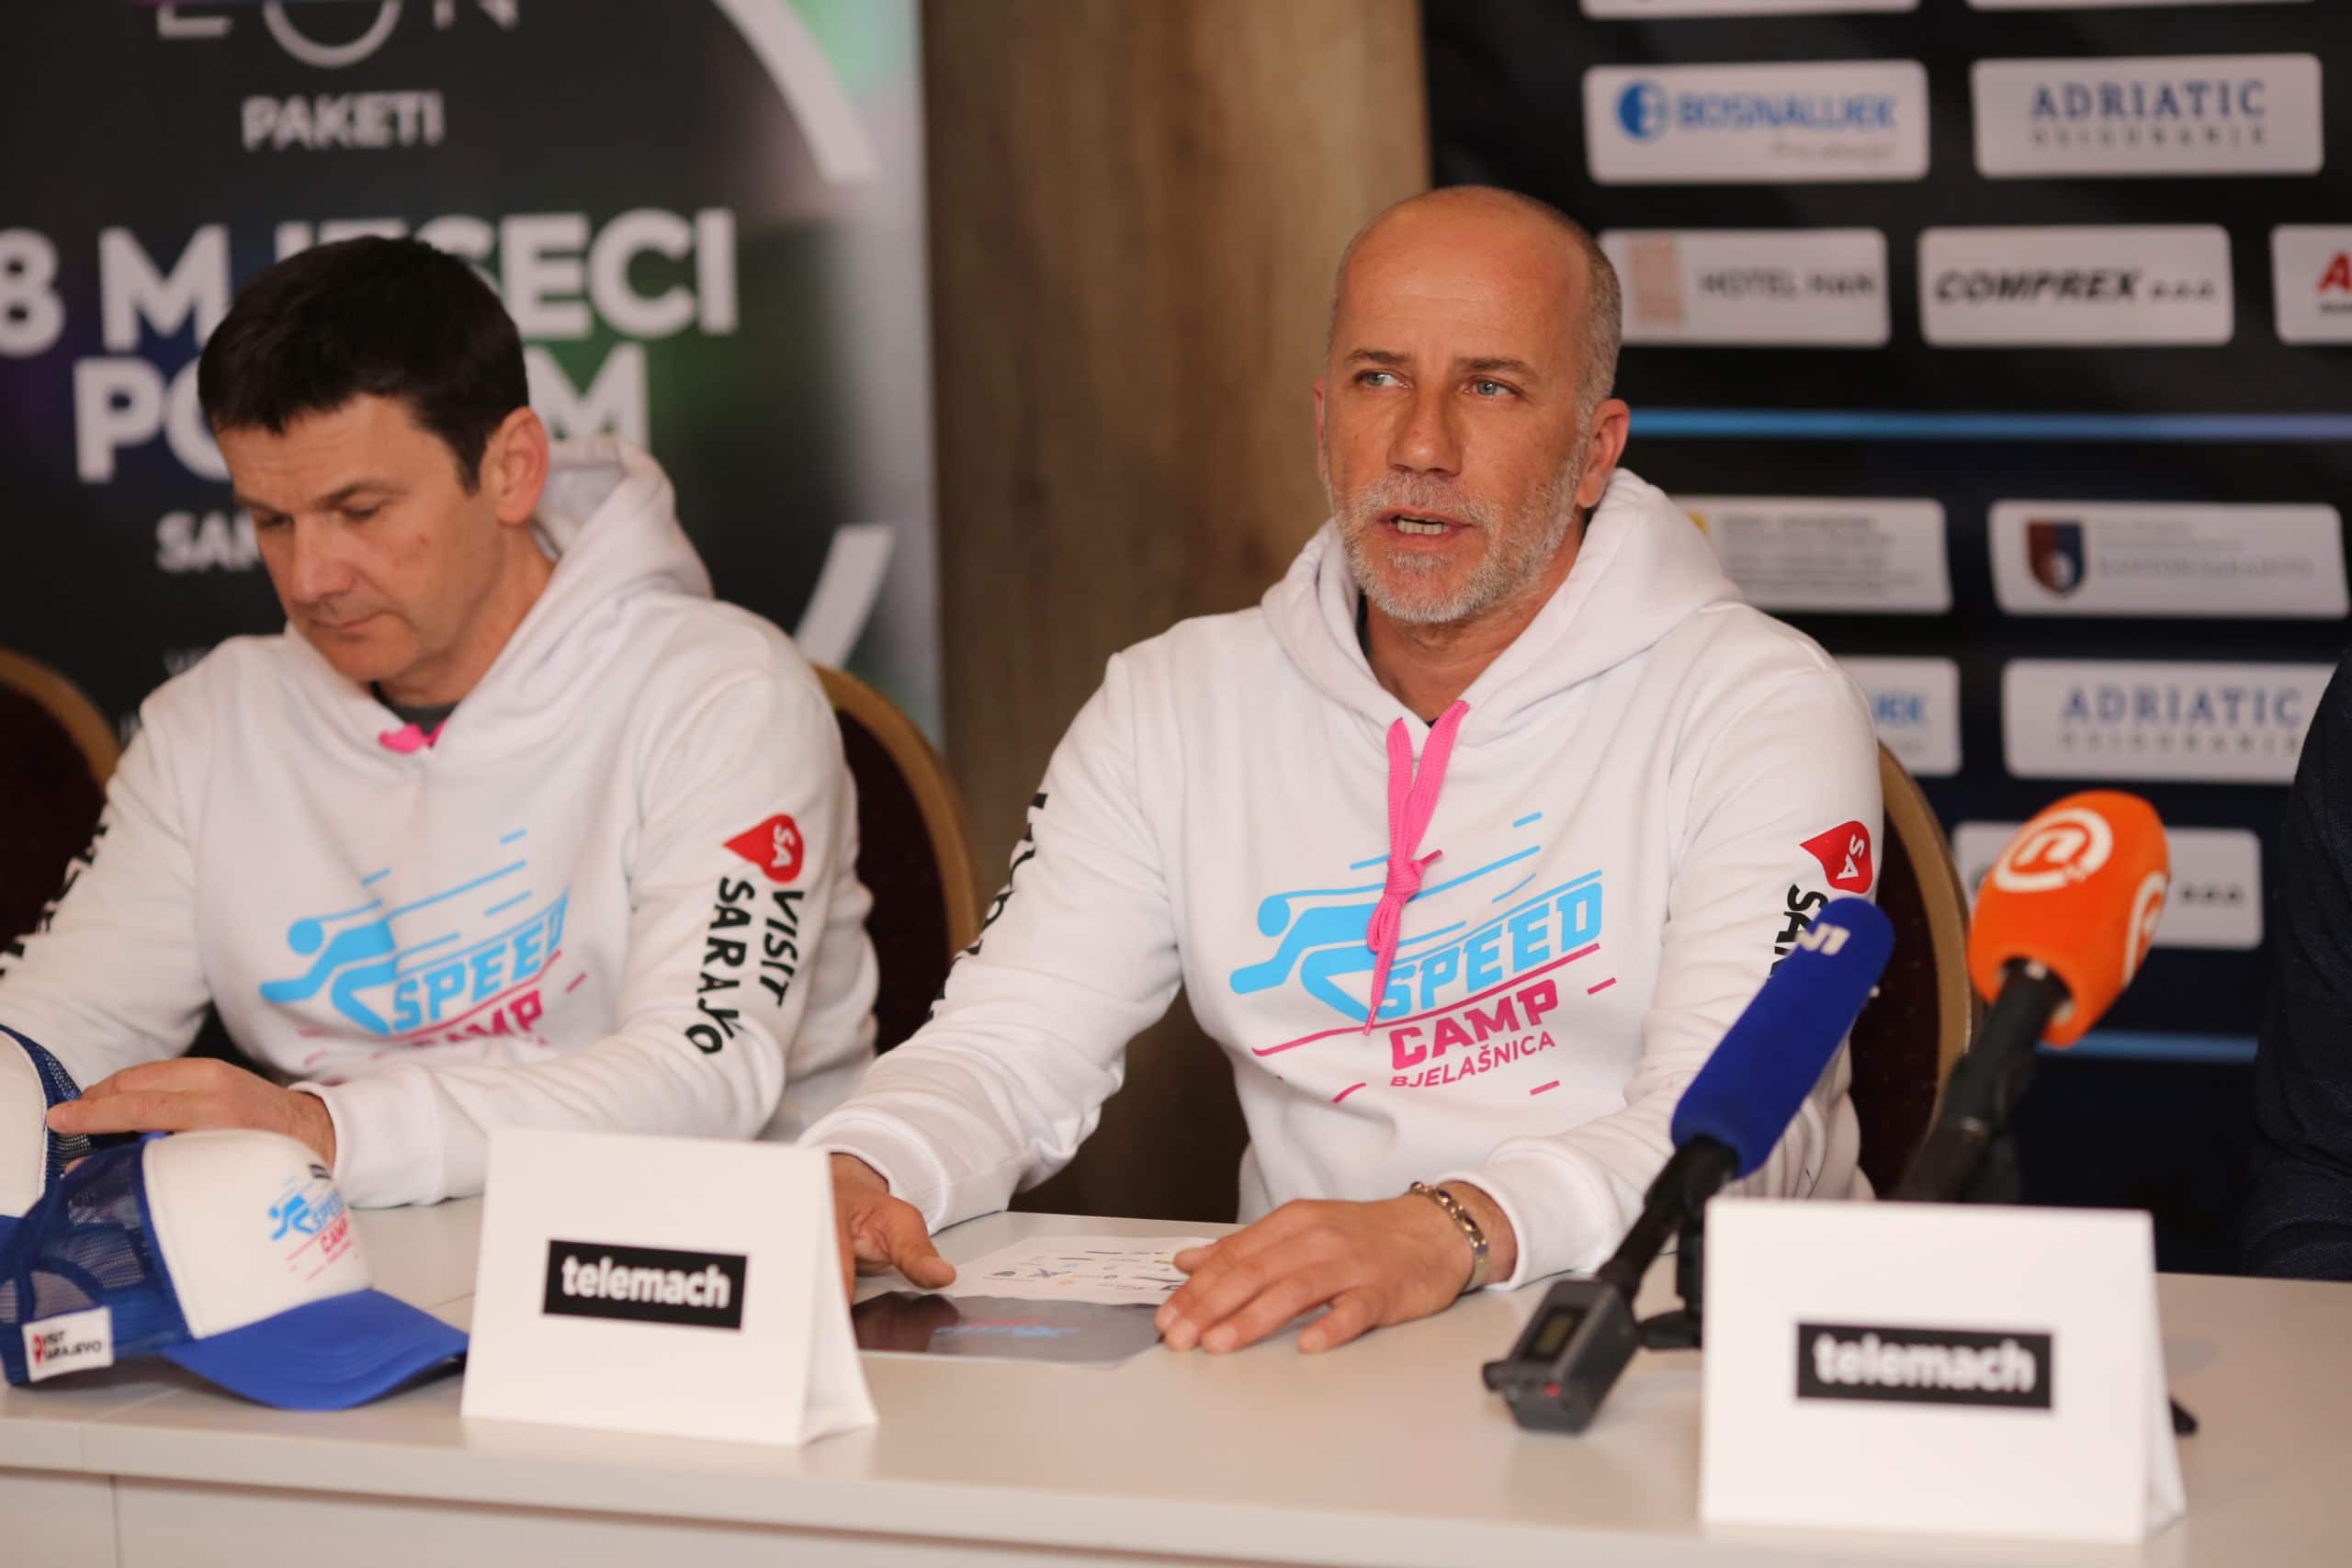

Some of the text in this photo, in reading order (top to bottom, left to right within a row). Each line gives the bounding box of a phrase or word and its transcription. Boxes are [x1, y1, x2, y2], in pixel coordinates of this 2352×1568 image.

[241, 91, 445, 151] PAKETI
[2030, 79, 2267, 120] ADRIATIC
[98, 208, 739, 354] MECI
[1934, 268, 2139, 303] COMPREX
[2061, 687, 2303, 727] ADRIATIC
[1837, 833, 1865, 880] SA
[759, 890, 805, 1007] VISIT
[1376, 882, 1603, 1021] SPEED
[1389, 978, 1559, 1071] CAMP
[1389, 1030, 1556, 1089] BJELAŠNICA
[560, 1255, 731, 1310] telemach
[1812, 1332, 2038, 1393] telemach
